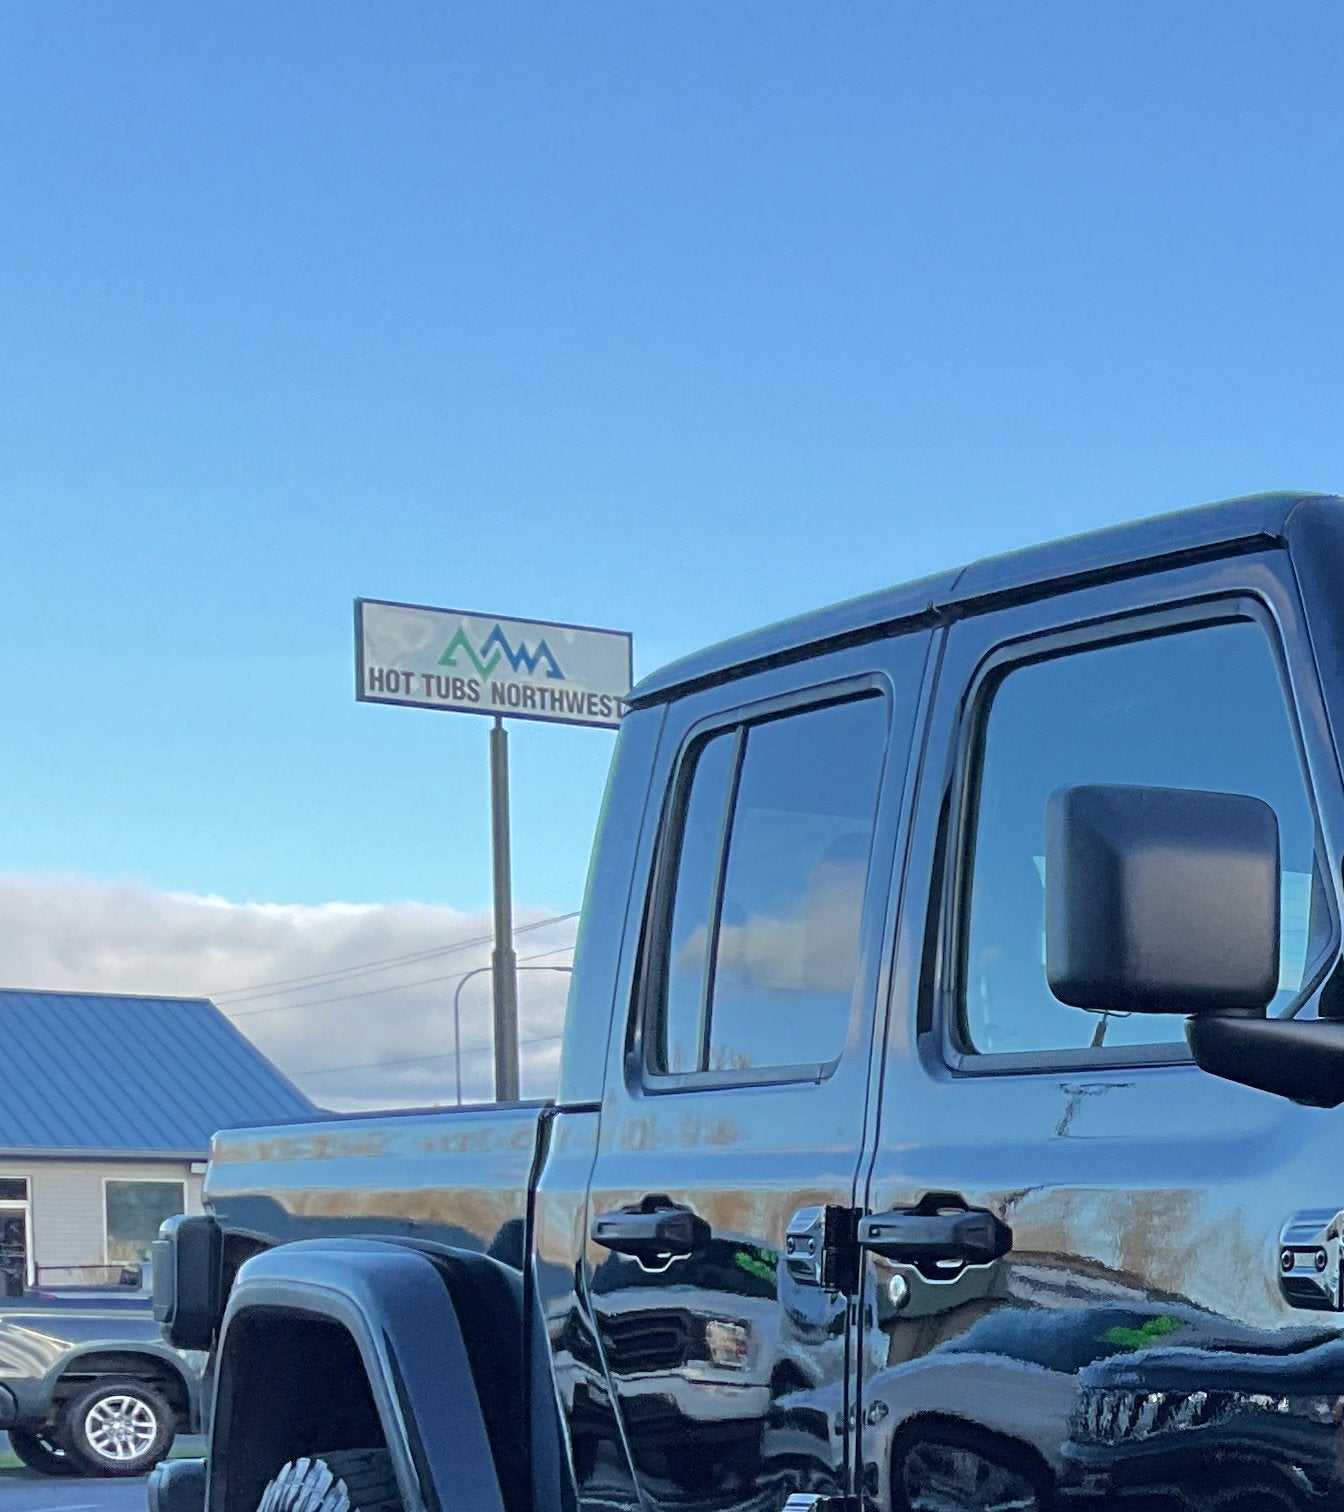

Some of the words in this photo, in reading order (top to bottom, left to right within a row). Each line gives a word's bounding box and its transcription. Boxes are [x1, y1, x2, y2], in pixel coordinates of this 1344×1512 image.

[369, 666, 415, 694] HOT
[421, 672, 480, 702] TUBS
[491, 680, 625, 718] NORTHWEST
